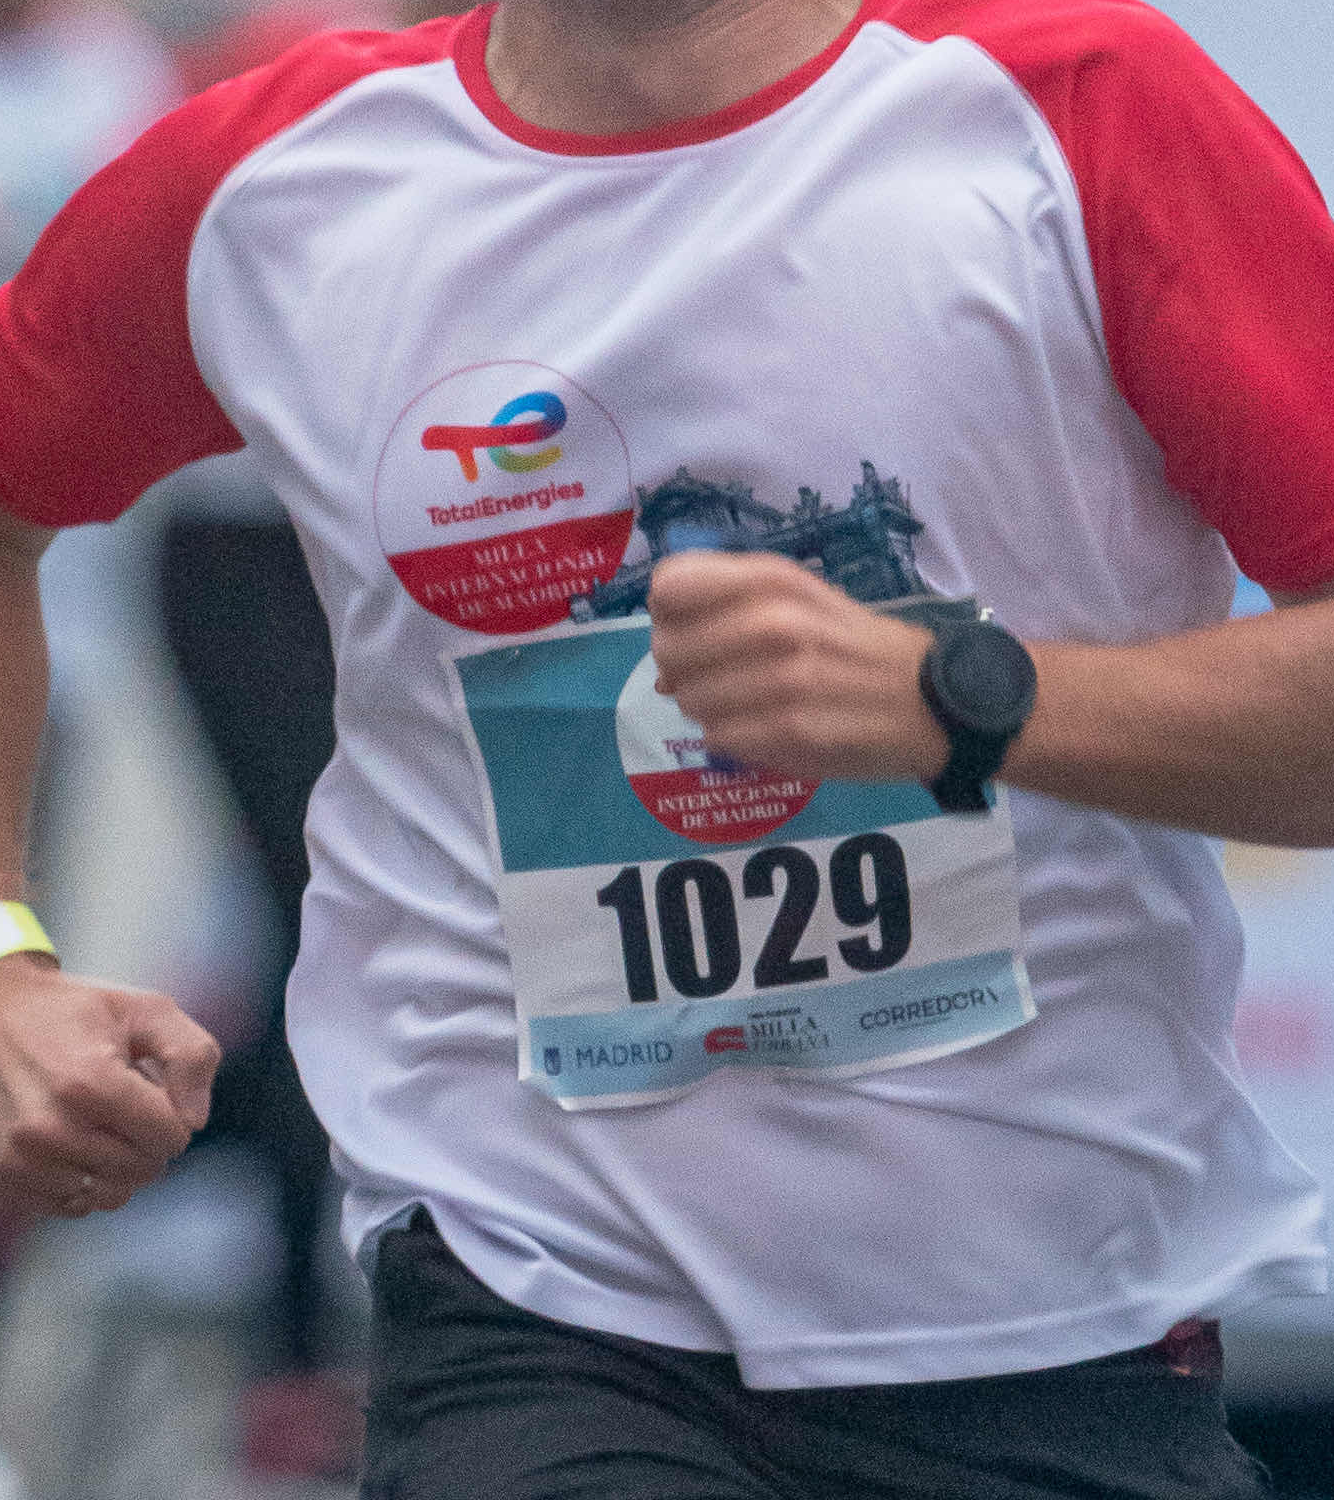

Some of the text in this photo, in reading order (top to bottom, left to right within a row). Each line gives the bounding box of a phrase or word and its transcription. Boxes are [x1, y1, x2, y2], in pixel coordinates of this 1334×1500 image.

[426, 481, 585, 525] TotalEnergies
[474, 538, 547, 565] MILLA
[423, 546, 606, 601] INTERNACIONAL
[457, 600, 484, 619] DE
[656, 780, 808, 813] INTERNACIONAL
[681, 802, 788, 829] DE MADRID
[597, 832, 912, 1003] 1029
[750, 1016, 818, 1038] MILLA
[575, 1041, 673, 1069] MADRID
